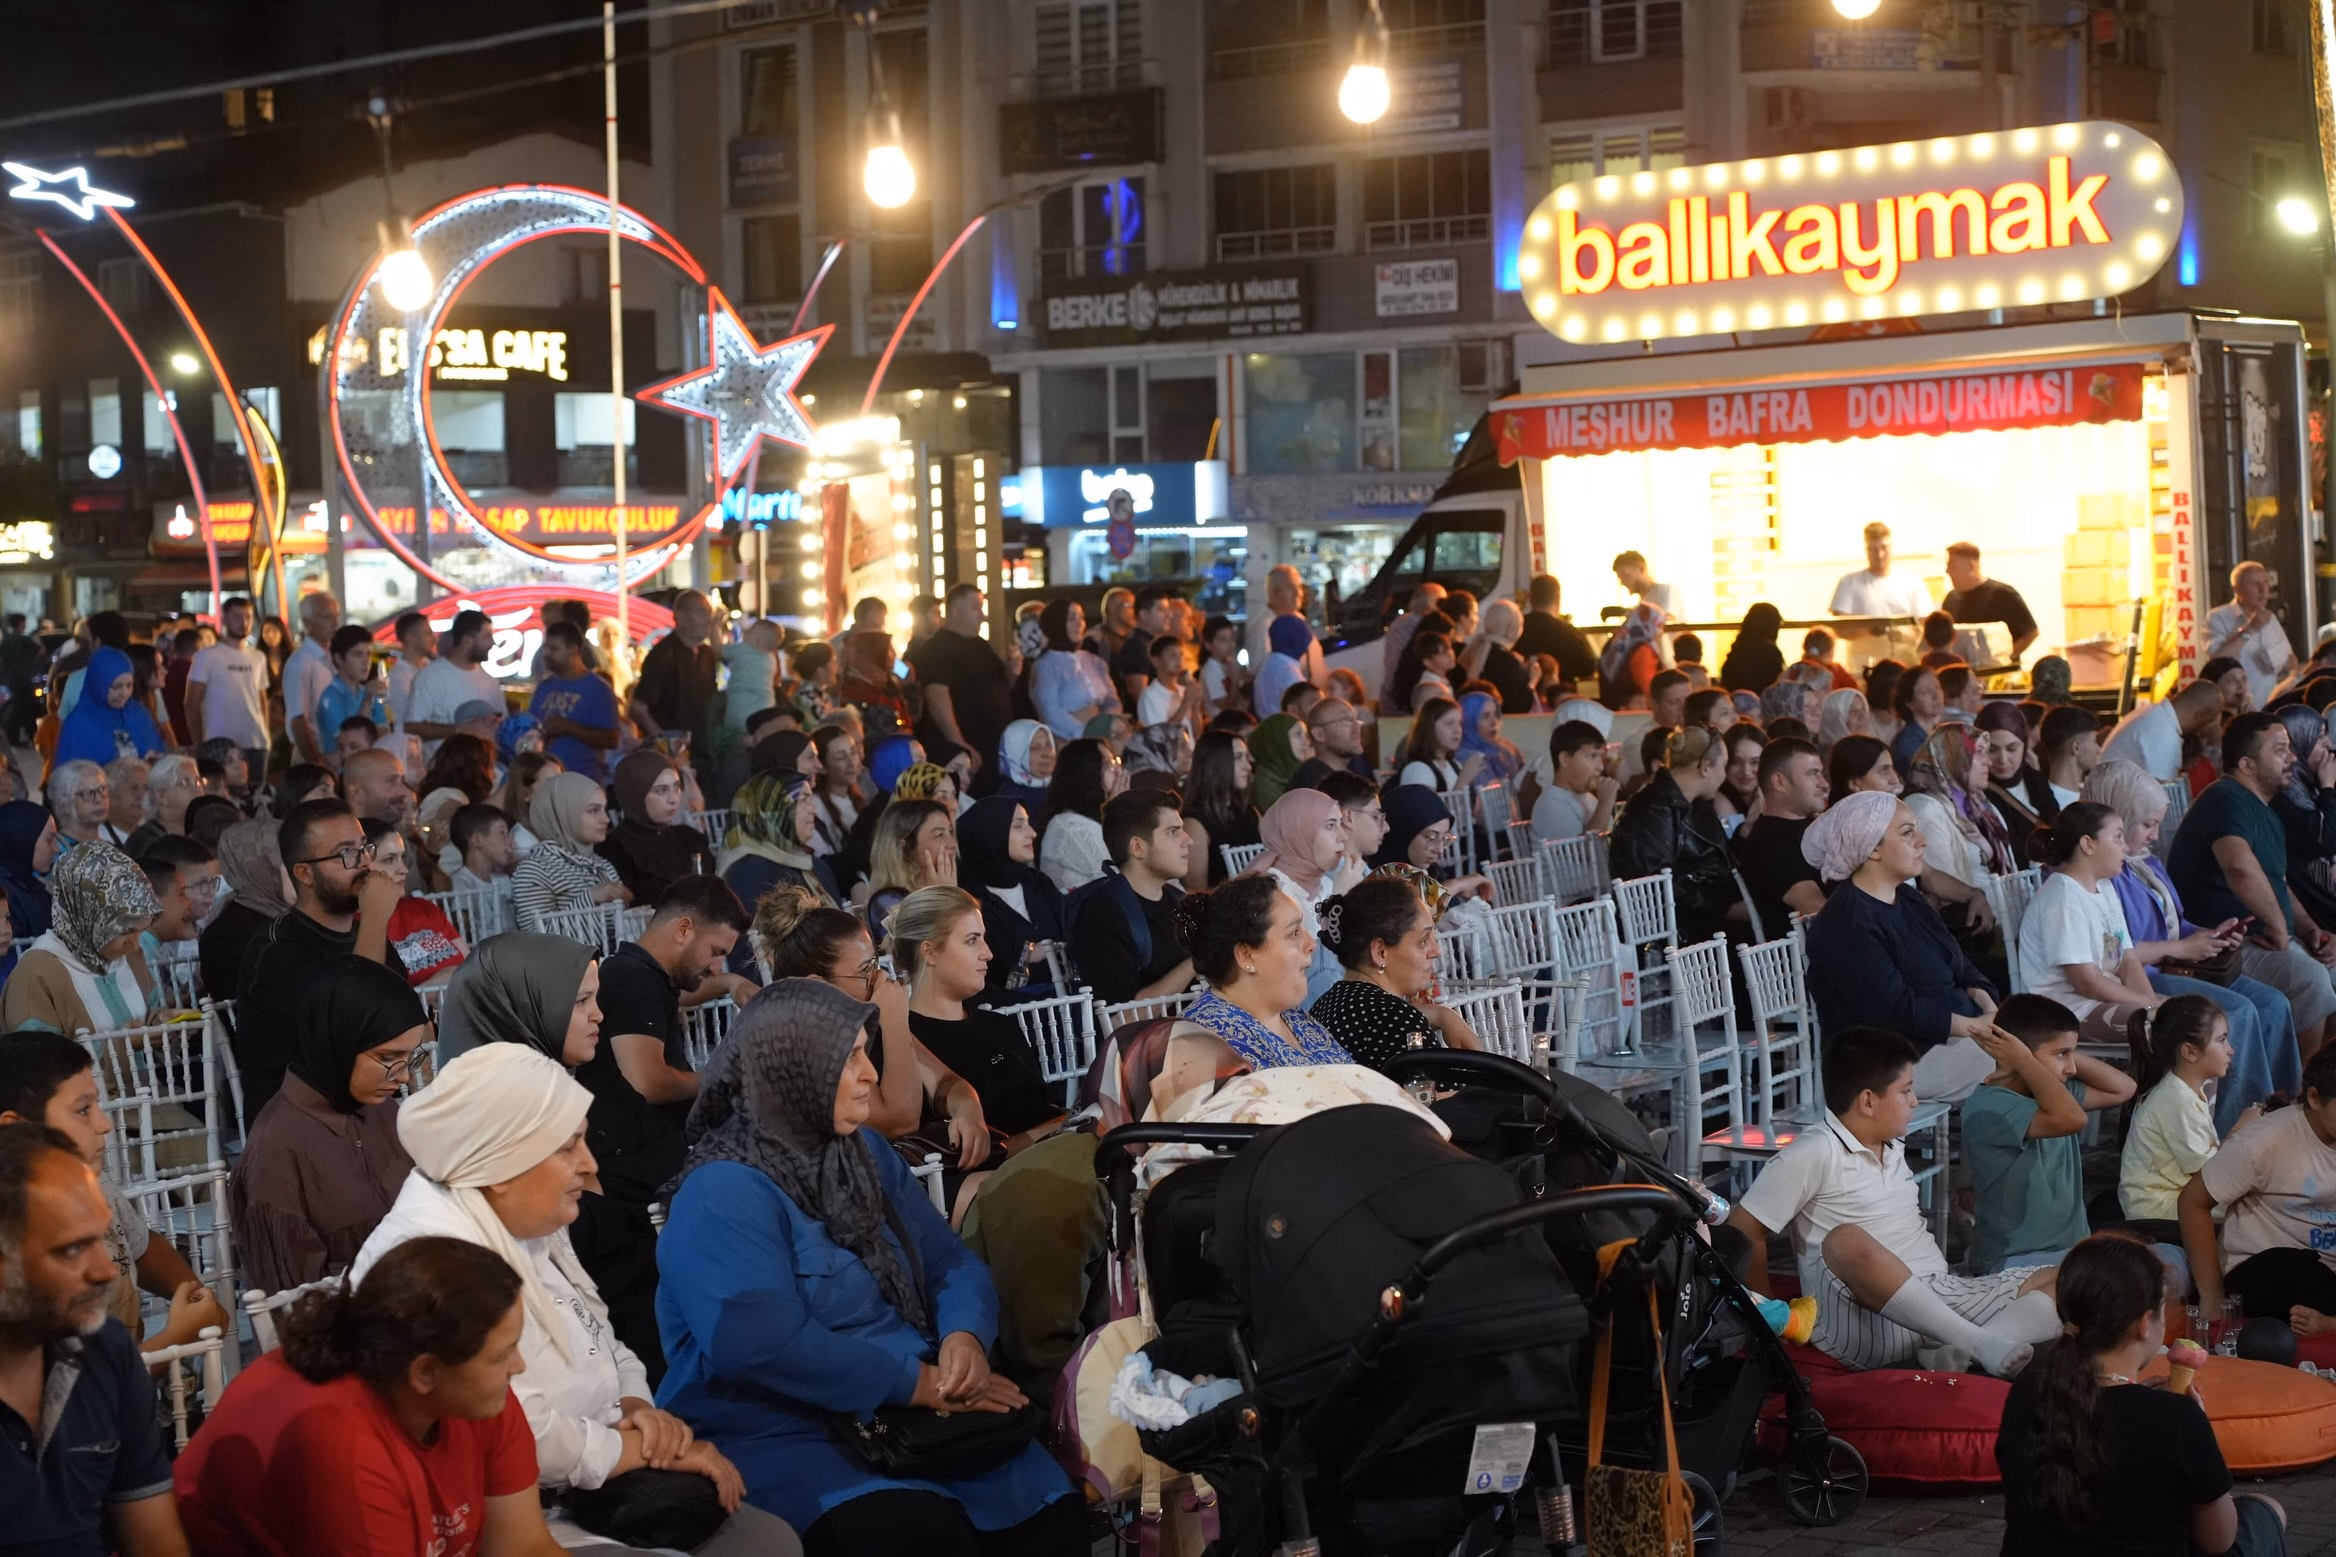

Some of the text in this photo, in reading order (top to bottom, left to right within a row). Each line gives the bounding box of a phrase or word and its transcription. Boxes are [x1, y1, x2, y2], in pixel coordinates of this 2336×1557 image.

[1558, 155, 2112, 296] ballıkaymak
[1047, 293, 1126, 331] BERKE
[492, 330, 568, 382] CAFE
[1544, 370, 2074, 455] MEŞHUR BAFRA DONDURMASI
